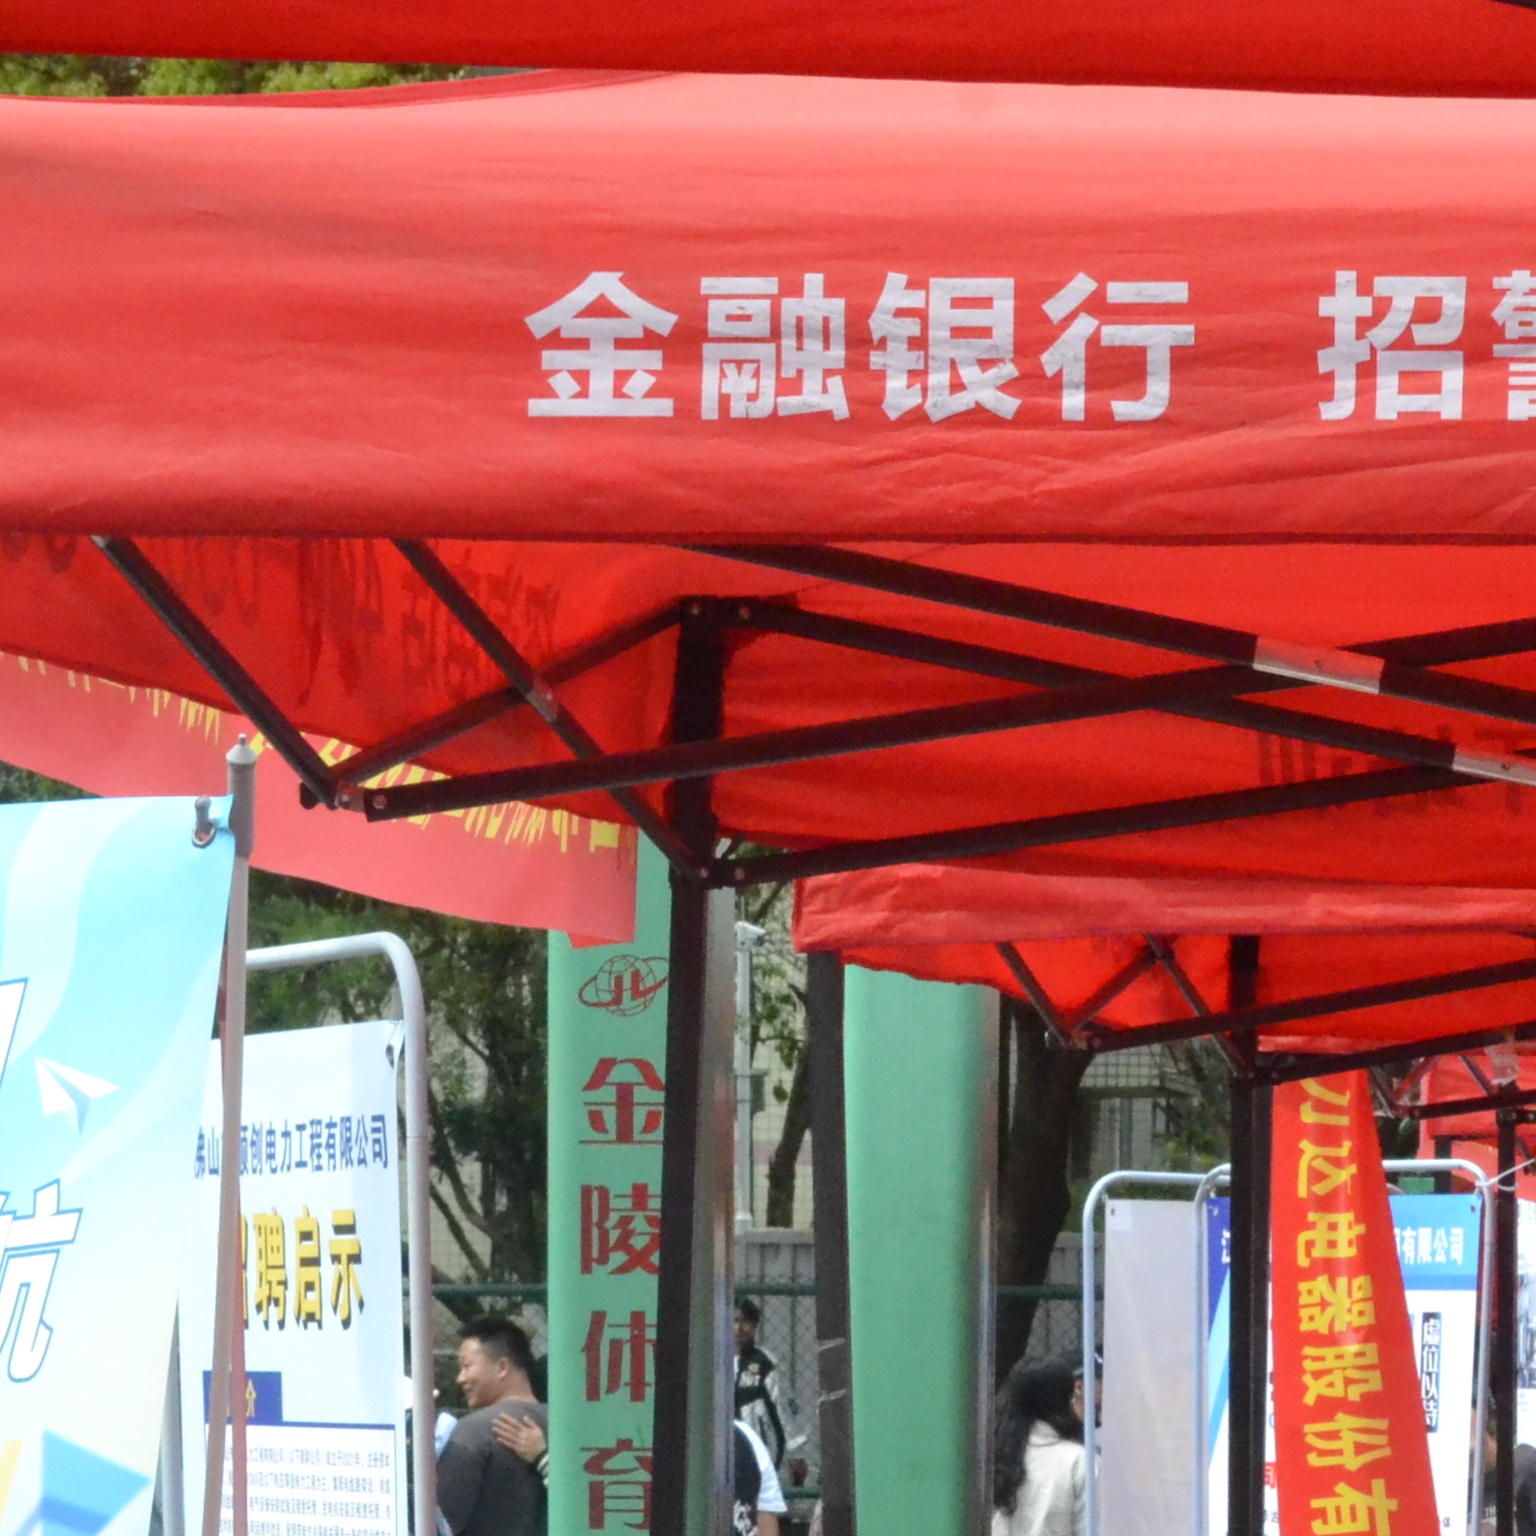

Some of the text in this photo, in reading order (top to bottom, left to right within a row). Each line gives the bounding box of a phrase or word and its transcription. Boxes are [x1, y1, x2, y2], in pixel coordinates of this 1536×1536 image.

[523, 268, 1194, 424] 金融银行
[239, 1204, 365, 1331] 聘启示
[578, 1056, 665, 1530] 金陵体育
